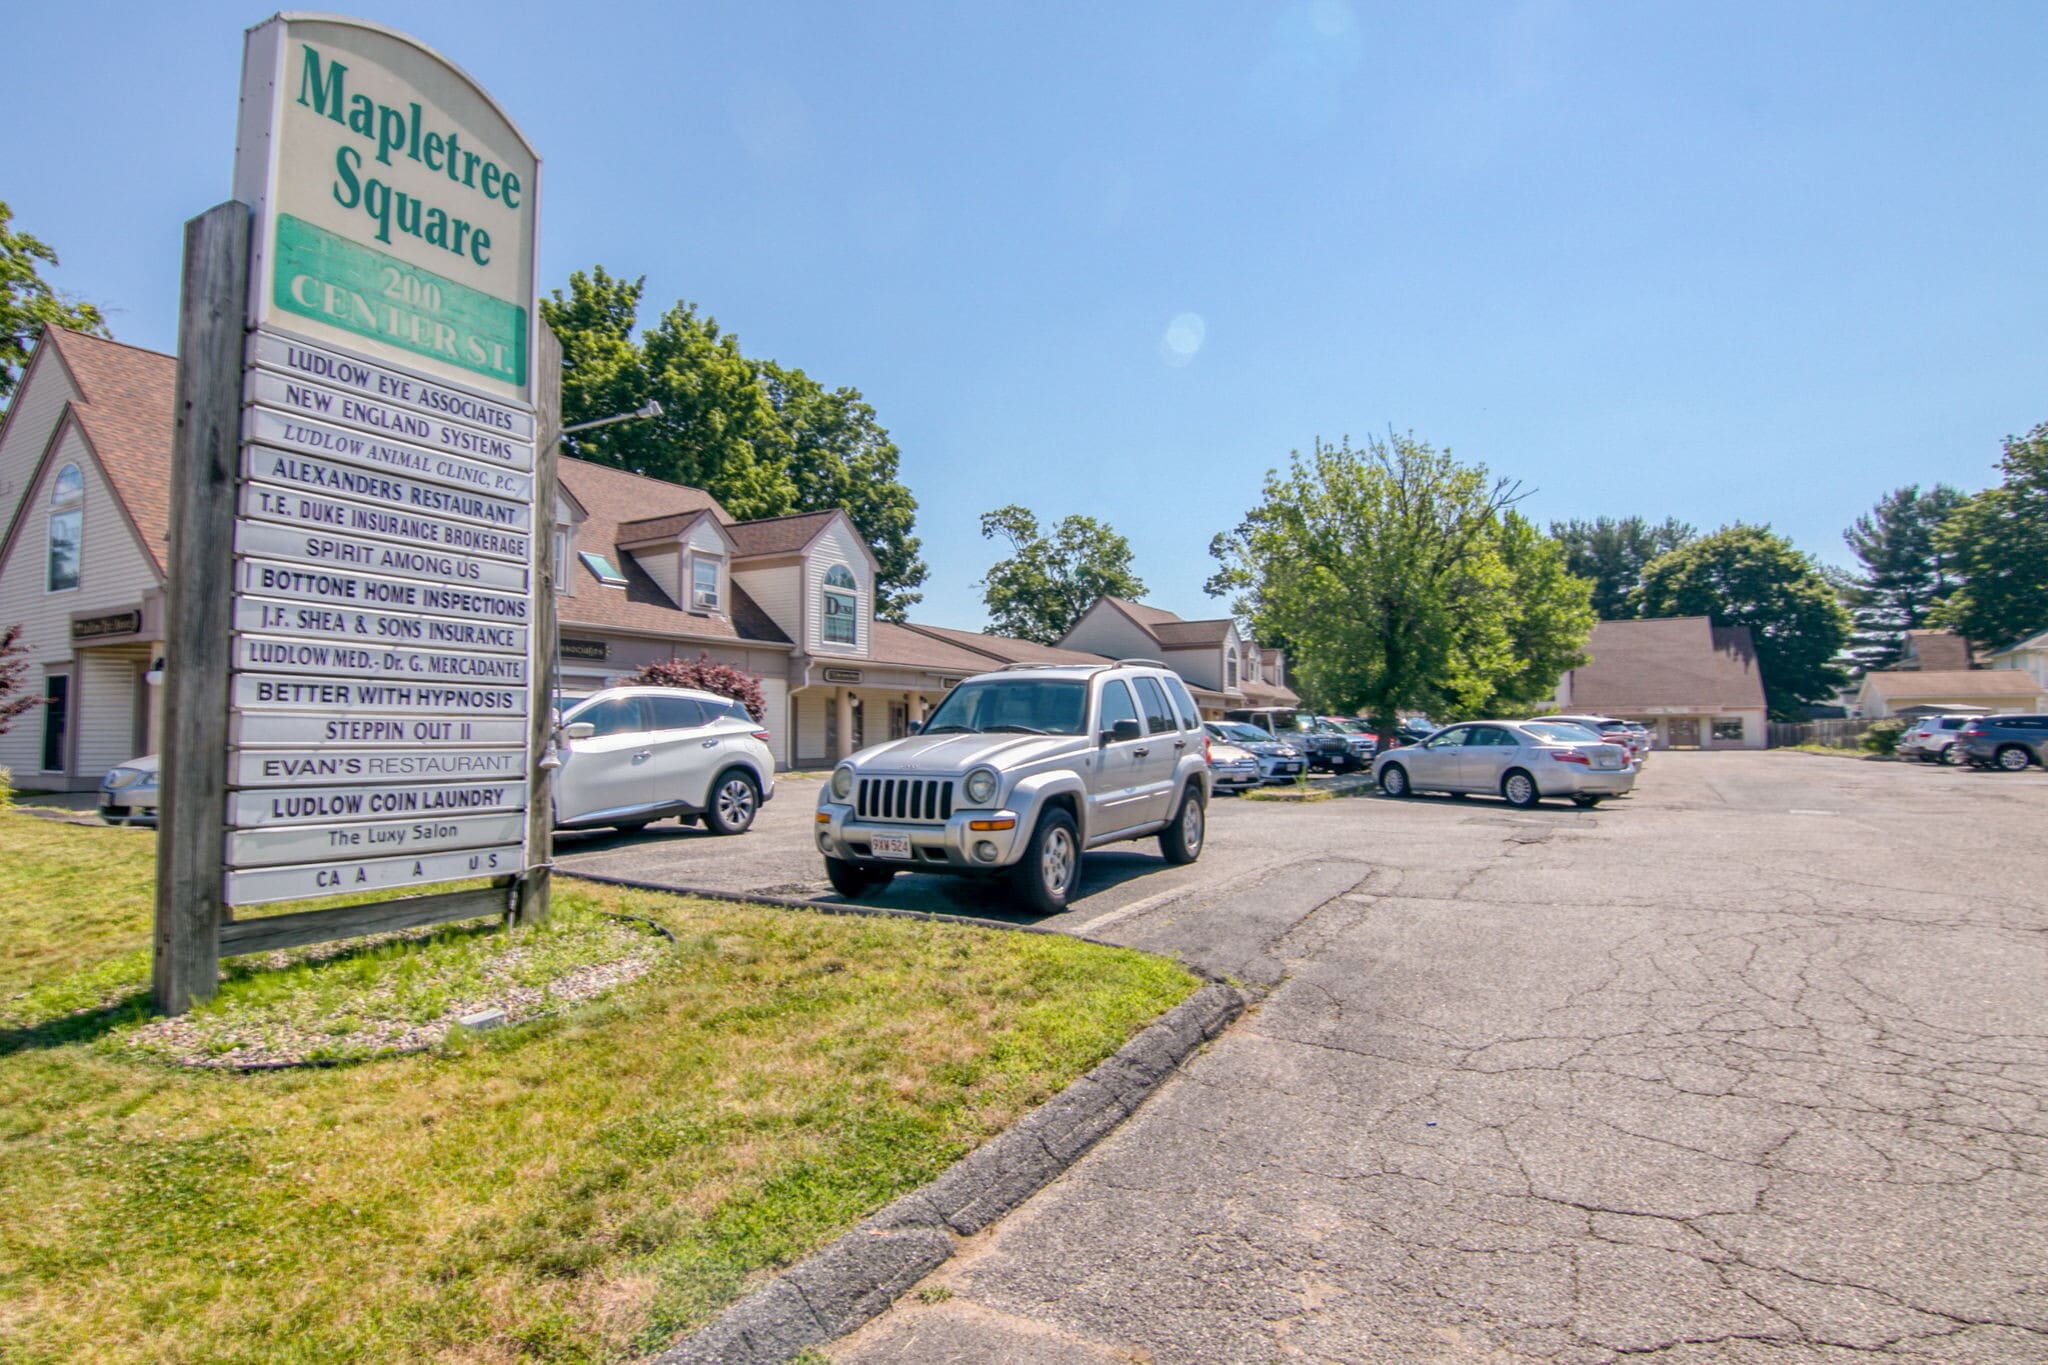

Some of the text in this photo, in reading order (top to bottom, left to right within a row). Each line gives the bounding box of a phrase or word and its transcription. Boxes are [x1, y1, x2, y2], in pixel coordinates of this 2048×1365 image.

[297, 44, 521, 209] Mapletree
[333, 146, 491, 266] Square
[383, 266, 441, 311] 200
[290, 274, 513, 375] CENTER ST.
[287, 348, 513, 430] LUDLOW EYE ASSOCIATES
[286, 385, 512, 460] NEW ENGLAND SYSTEMS
[283, 425, 364, 456] LUDLOW
[366, 446, 431, 473] ANIMAL
[272, 458, 516, 525] ALEXANDERS RESTAURANT
[259, 492, 524, 556] T.E. DUKE INSURANCE BROKERAGE
[305, 538, 480, 580] SPIRIT AMONG US
[262, 568, 526, 618] BOTTONE HOME INSPECTIONS
[298, 609, 345, 632] SHEA
[354, 615, 368, 634] &
[377, 618, 422, 638] SONS
[429, 622, 514, 647] INSURANCE
[249, 642, 329, 666] LUDLOW
[383, 652, 403, 670] Dr.
[409, 654, 423, 672] G.
[428, 656, 520, 678] MERCADANTE
[257, 682, 513, 709] BETTER WITH HYPNOSIS
[325, 721, 403, 740] STEPPIN
[414, 722, 451, 740] OUT
[263, 755, 513, 777] EVAN'S RESTAURANT
[272, 788, 505, 819] LUDLOW COIN LAUNDRY
[328, 824, 457, 847] The Luxy Salon
